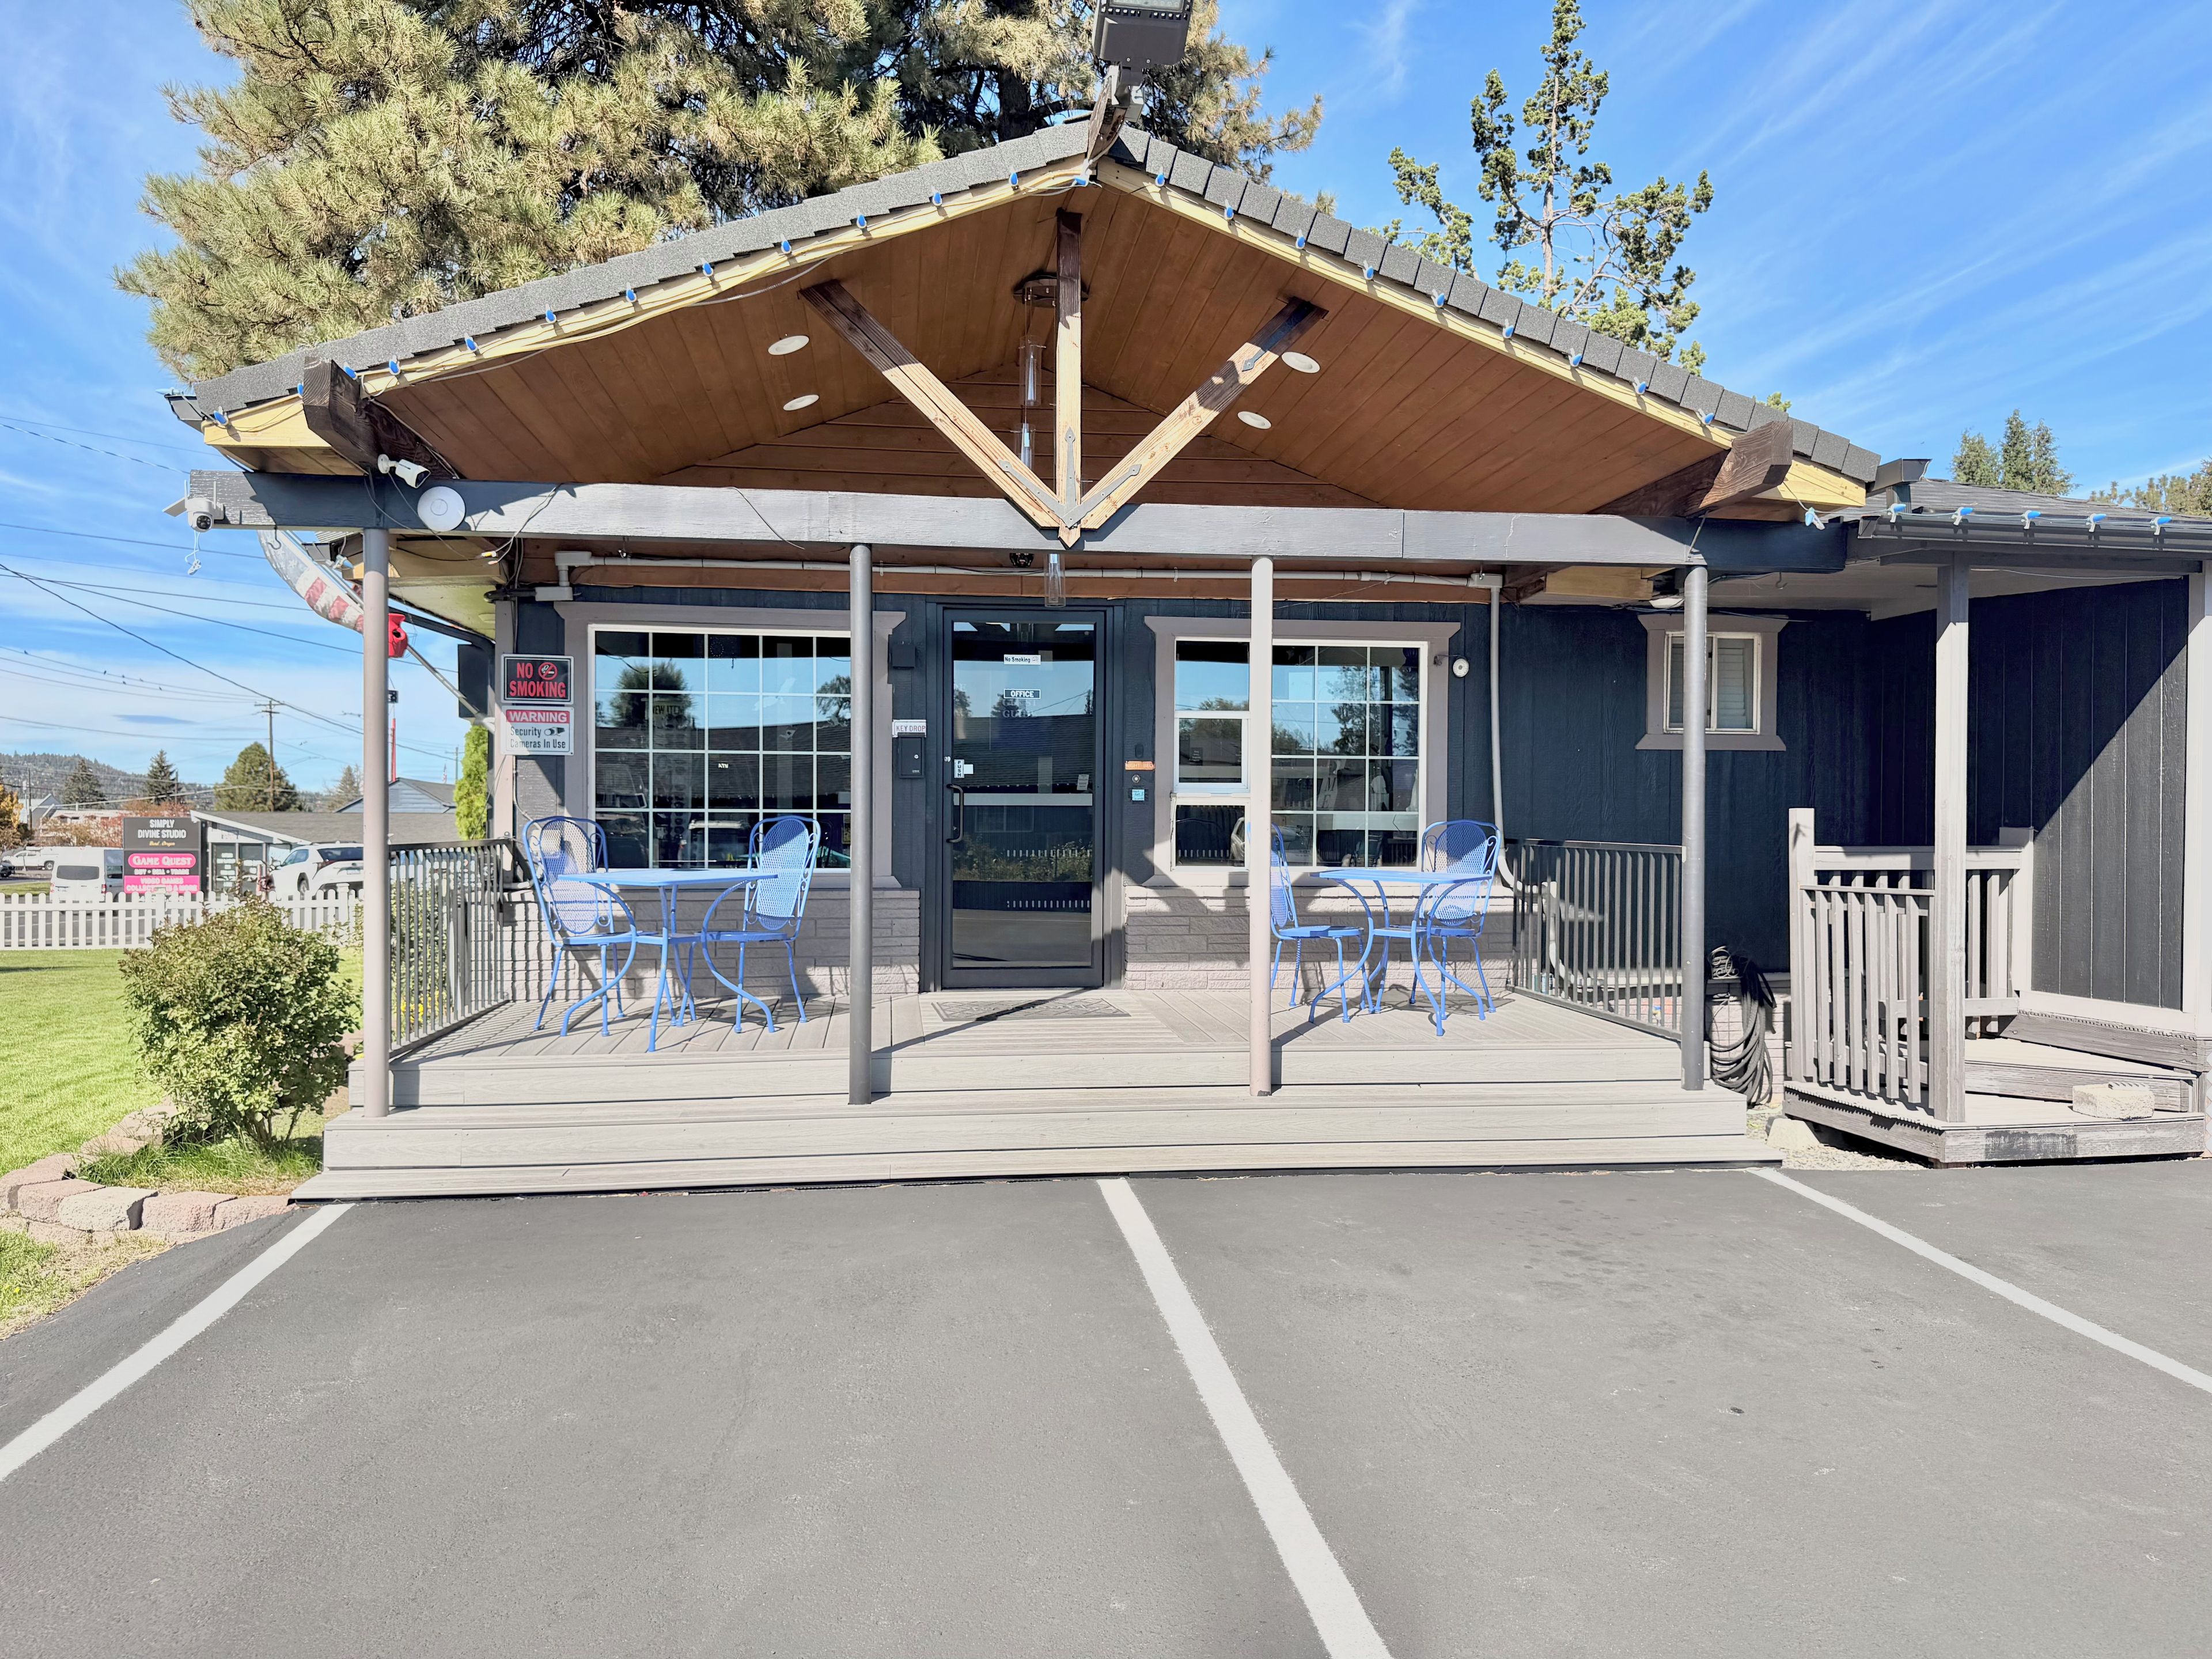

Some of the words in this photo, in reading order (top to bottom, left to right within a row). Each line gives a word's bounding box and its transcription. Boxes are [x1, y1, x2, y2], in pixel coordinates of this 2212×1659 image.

[517, 662, 533, 679] NO
[509, 680, 566, 698] SMOKING
[509, 711, 567, 722] WARNING
[510, 726, 541, 737] Security
[510, 739, 541, 748] Cameras
[544, 740, 551, 748] In
[553, 740, 566, 748] Use
[149, 819, 175, 828] SIMPLY
[138, 830, 160, 839] DIVINE
[161, 830, 187, 839] STUDIO
[132, 855, 160, 866] GAME
[161, 856, 192, 866] QUEST
